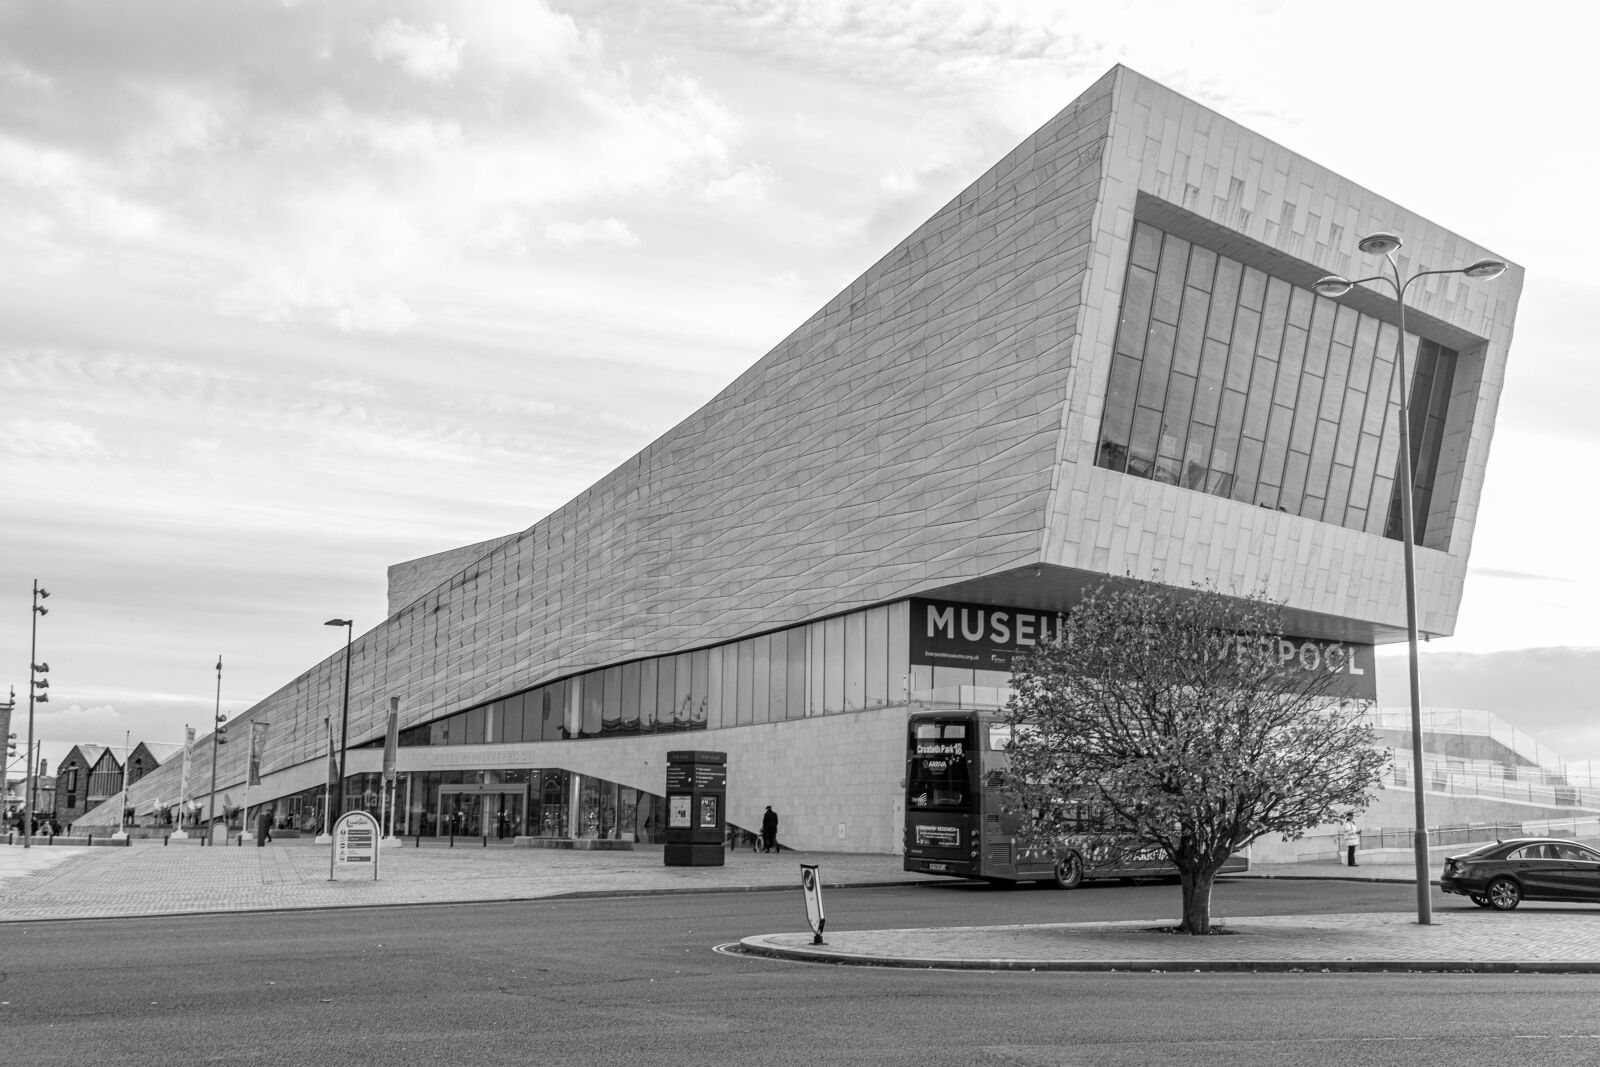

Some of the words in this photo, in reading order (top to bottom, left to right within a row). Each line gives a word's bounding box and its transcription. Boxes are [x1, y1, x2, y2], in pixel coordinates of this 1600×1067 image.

[927, 604, 1072, 650] MUSEU
[941, 744, 954, 753] Park
[954, 742, 962, 755] 18
